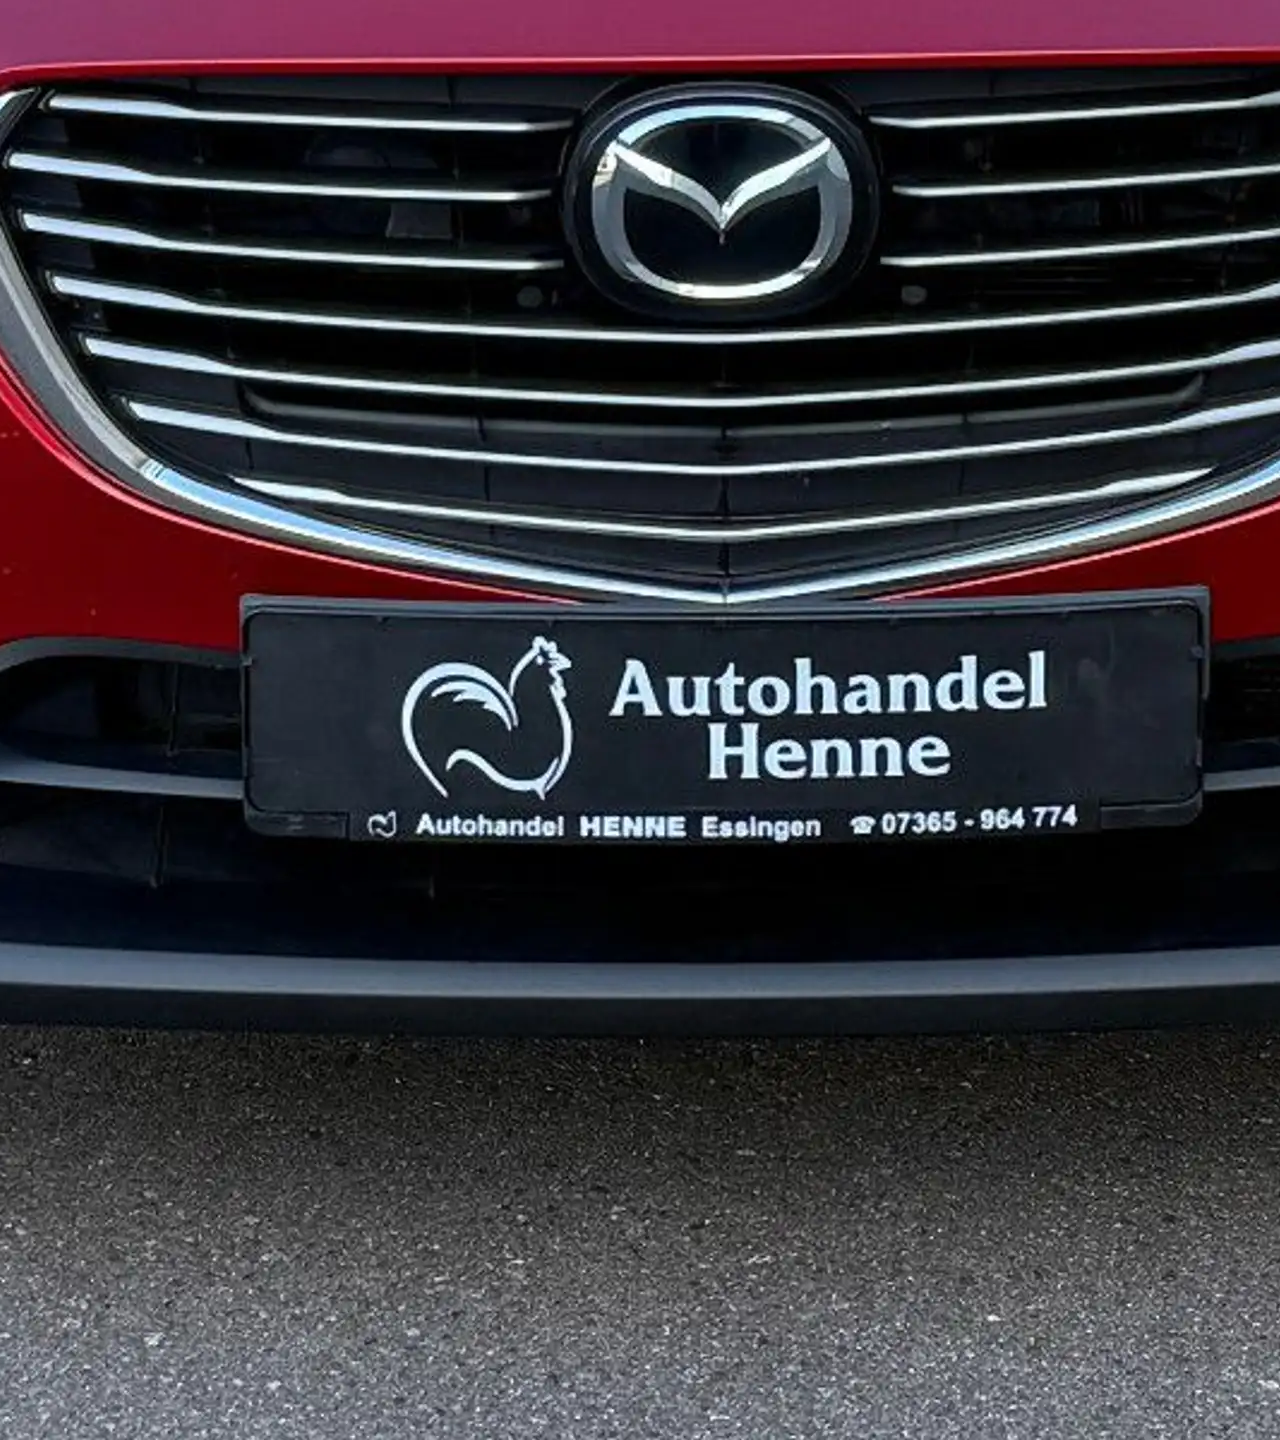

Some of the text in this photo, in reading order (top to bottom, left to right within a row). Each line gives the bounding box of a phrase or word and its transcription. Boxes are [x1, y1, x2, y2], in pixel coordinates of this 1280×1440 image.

[609, 650, 1048, 717] Autohandel
[706, 721, 952, 780] Henne
[415, 812, 565, 837] Autohandel
[579, 815, 687, 839] HENNE
[701, 814, 821, 842] Essingen
[880, 810, 957, 835] 07365
[980, 806, 1025, 831] 964
[1031, 803, 1079, 827] 774
